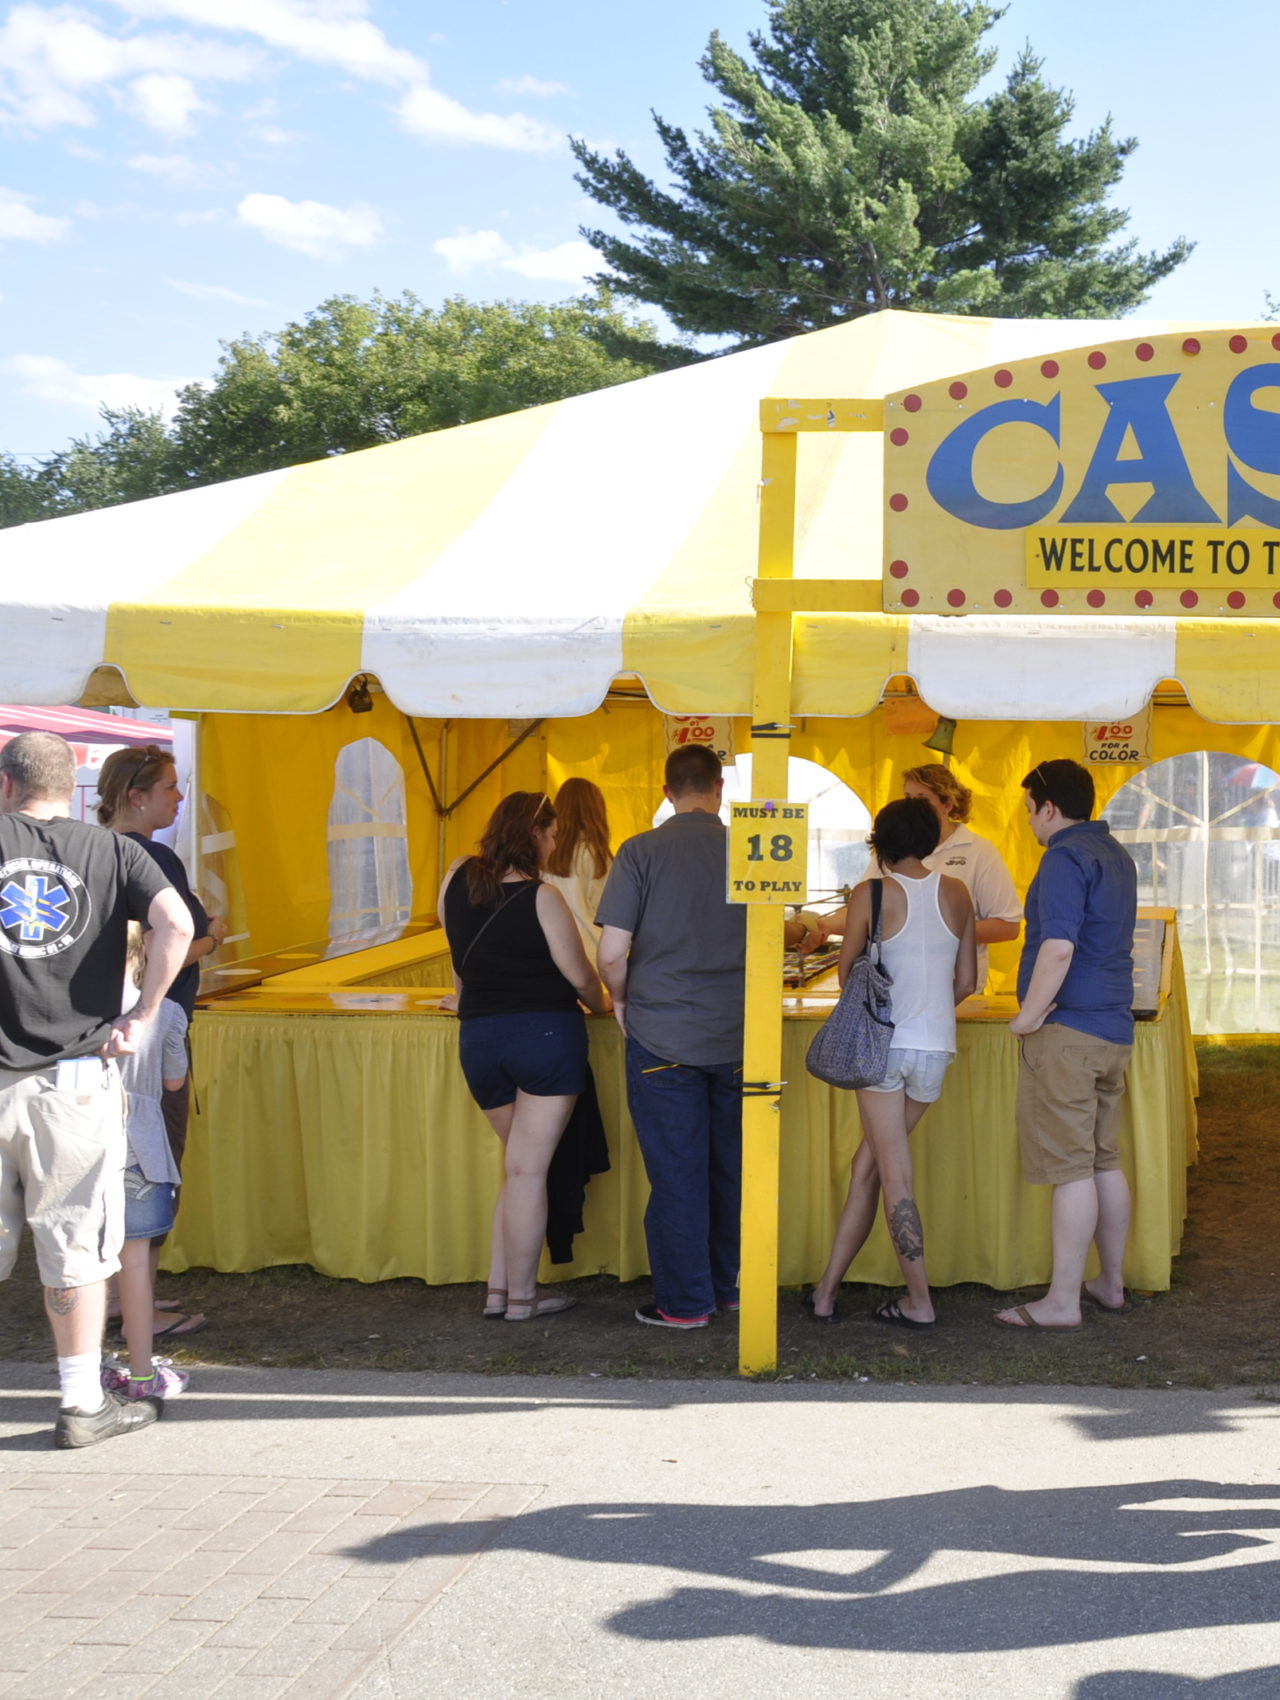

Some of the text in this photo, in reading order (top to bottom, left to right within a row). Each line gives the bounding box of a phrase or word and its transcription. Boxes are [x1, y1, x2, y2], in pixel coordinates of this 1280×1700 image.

[1039, 538, 1194, 573] WELCOME
[1207, 540, 1250, 575] TO
[1089, 750, 1139, 761] COLOR
[733, 808, 804, 819] MUST BE
[747, 834, 793, 861] 18
[733, 881, 802, 892] TO PLAY
